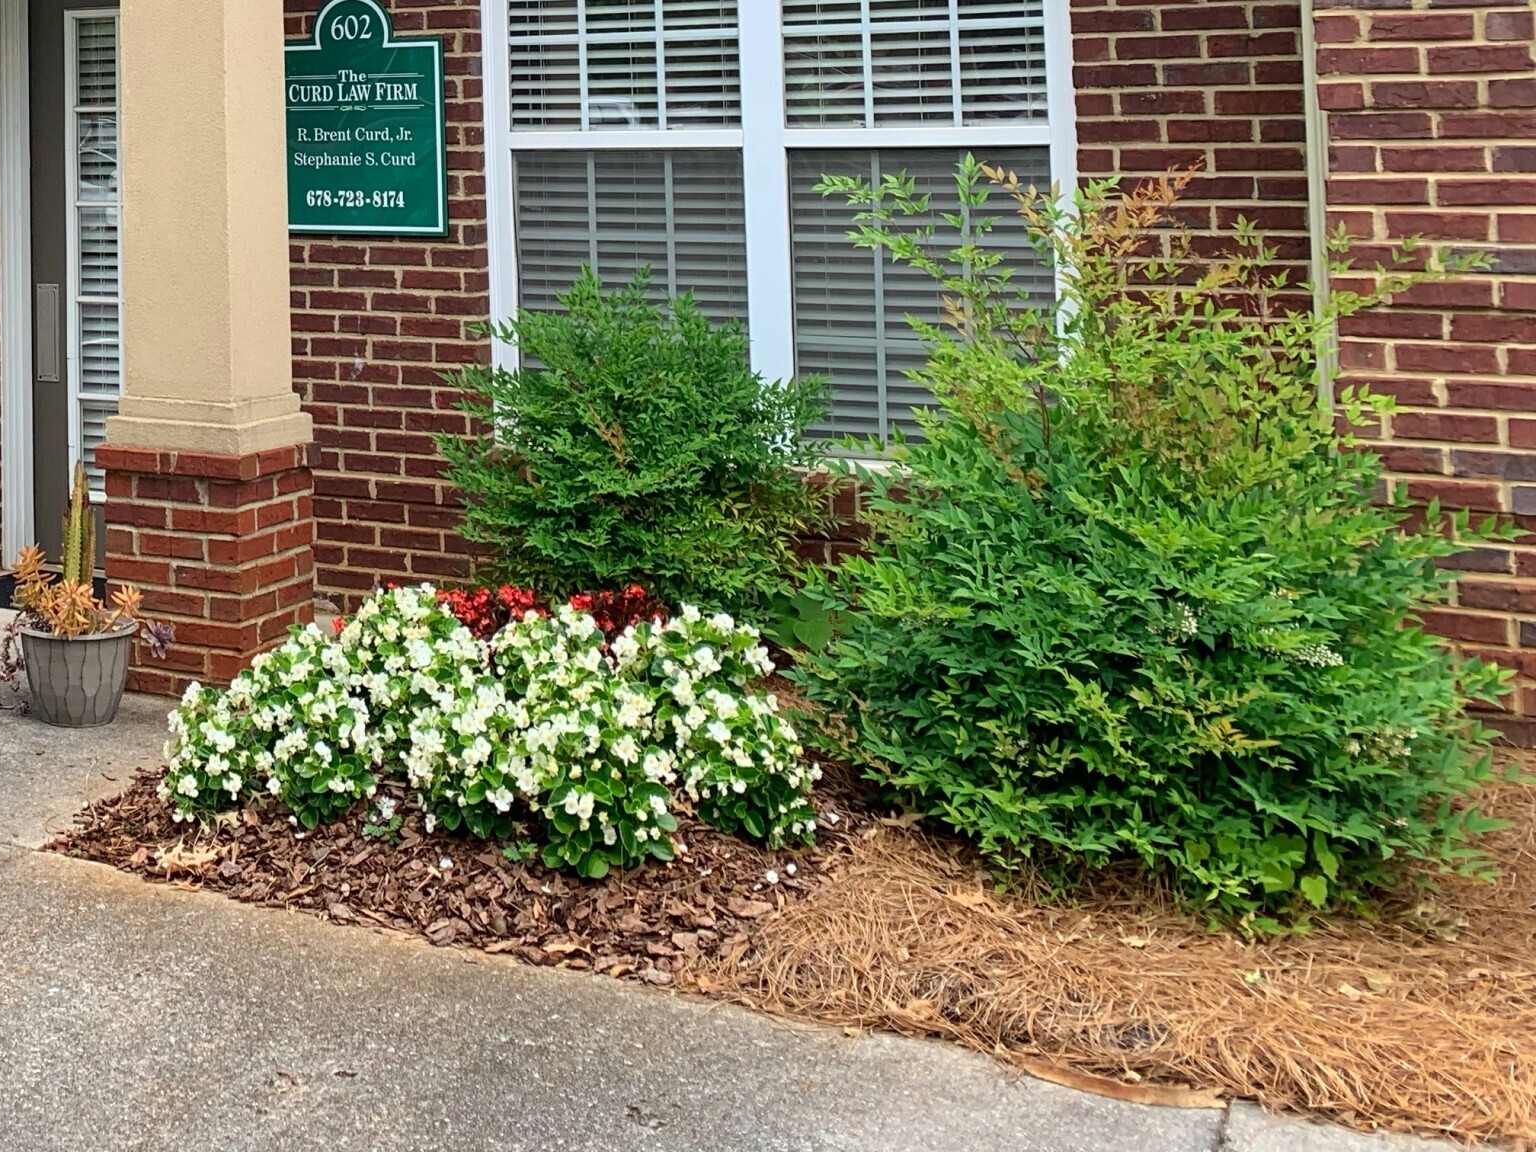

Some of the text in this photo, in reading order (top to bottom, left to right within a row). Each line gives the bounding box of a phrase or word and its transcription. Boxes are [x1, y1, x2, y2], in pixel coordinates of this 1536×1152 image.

[330, 14, 372, 40] 602
[338, 69, 367, 83] The
[288, 82, 418, 102] CURD LAW FIRM
[297, 127, 413, 143] R. Brent Curd, Jr.
[294, 152, 416, 169] Stephanie S. Curd
[306, 190, 405, 208] 678-723-8174
